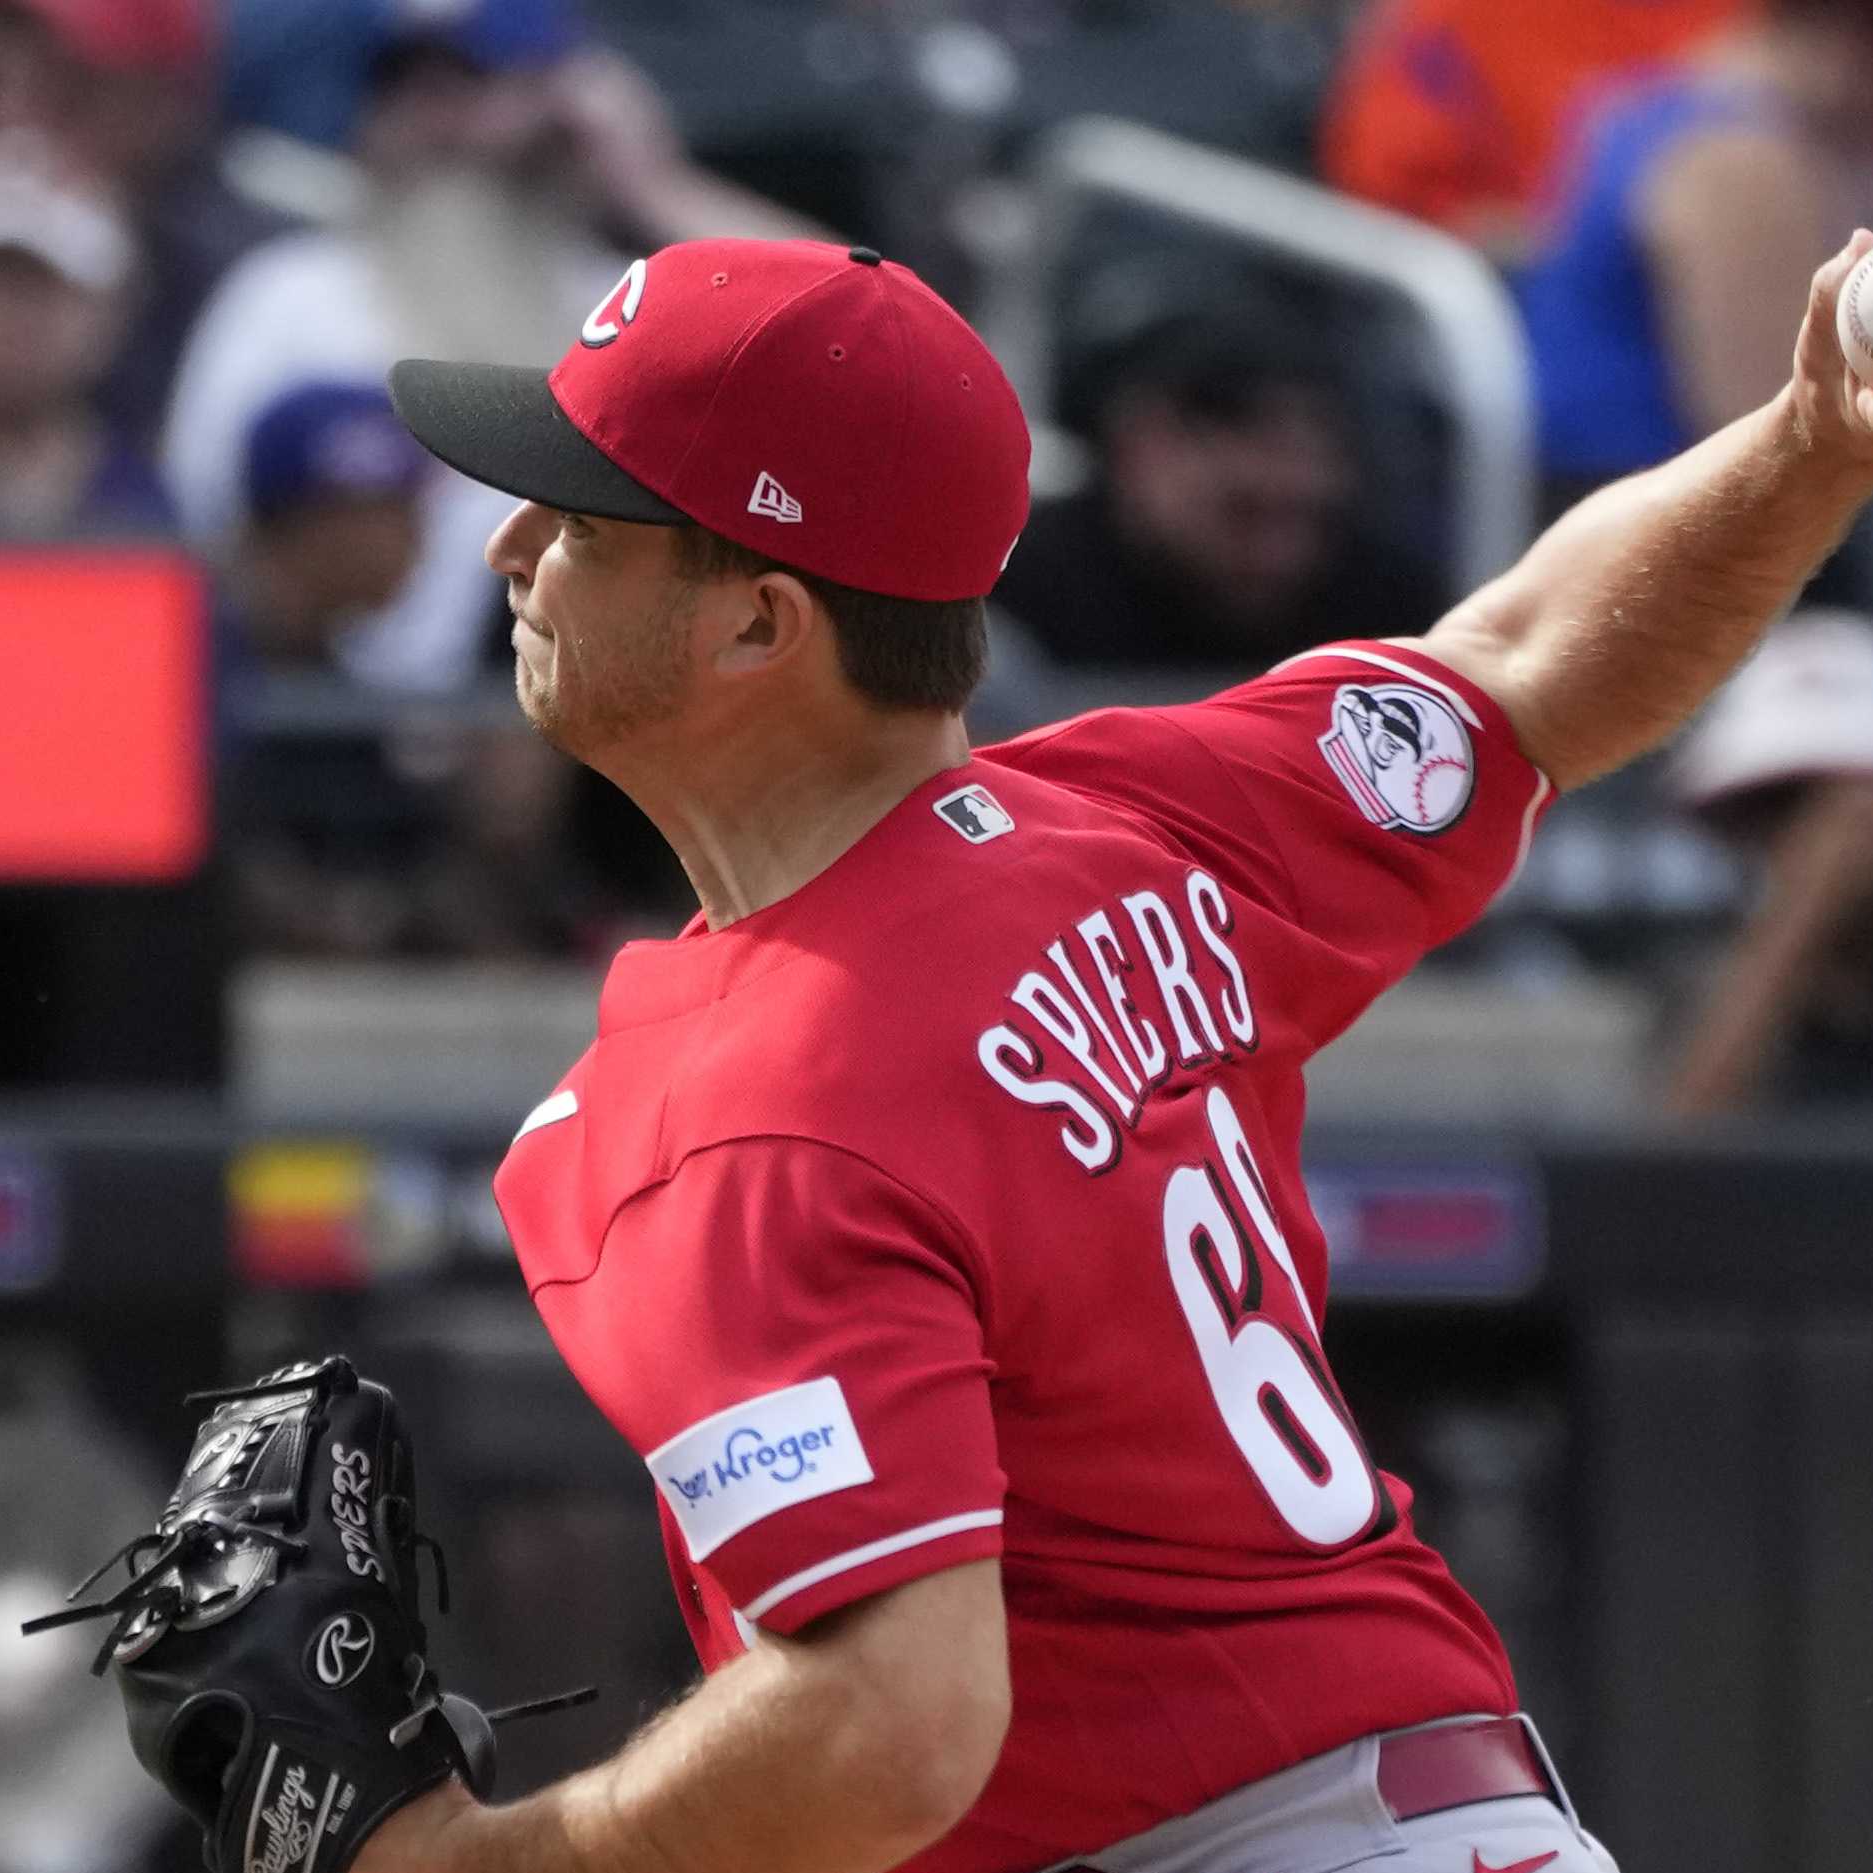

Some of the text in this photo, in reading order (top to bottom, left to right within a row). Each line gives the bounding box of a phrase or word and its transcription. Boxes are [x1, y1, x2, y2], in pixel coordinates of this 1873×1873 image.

[581, 259, 647, 348] C
[977, 868, 1257, 1175] SPIERS
[331, 1442, 387, 1584] SPIERS
[713, 1427, 835, 1489] Kroger
